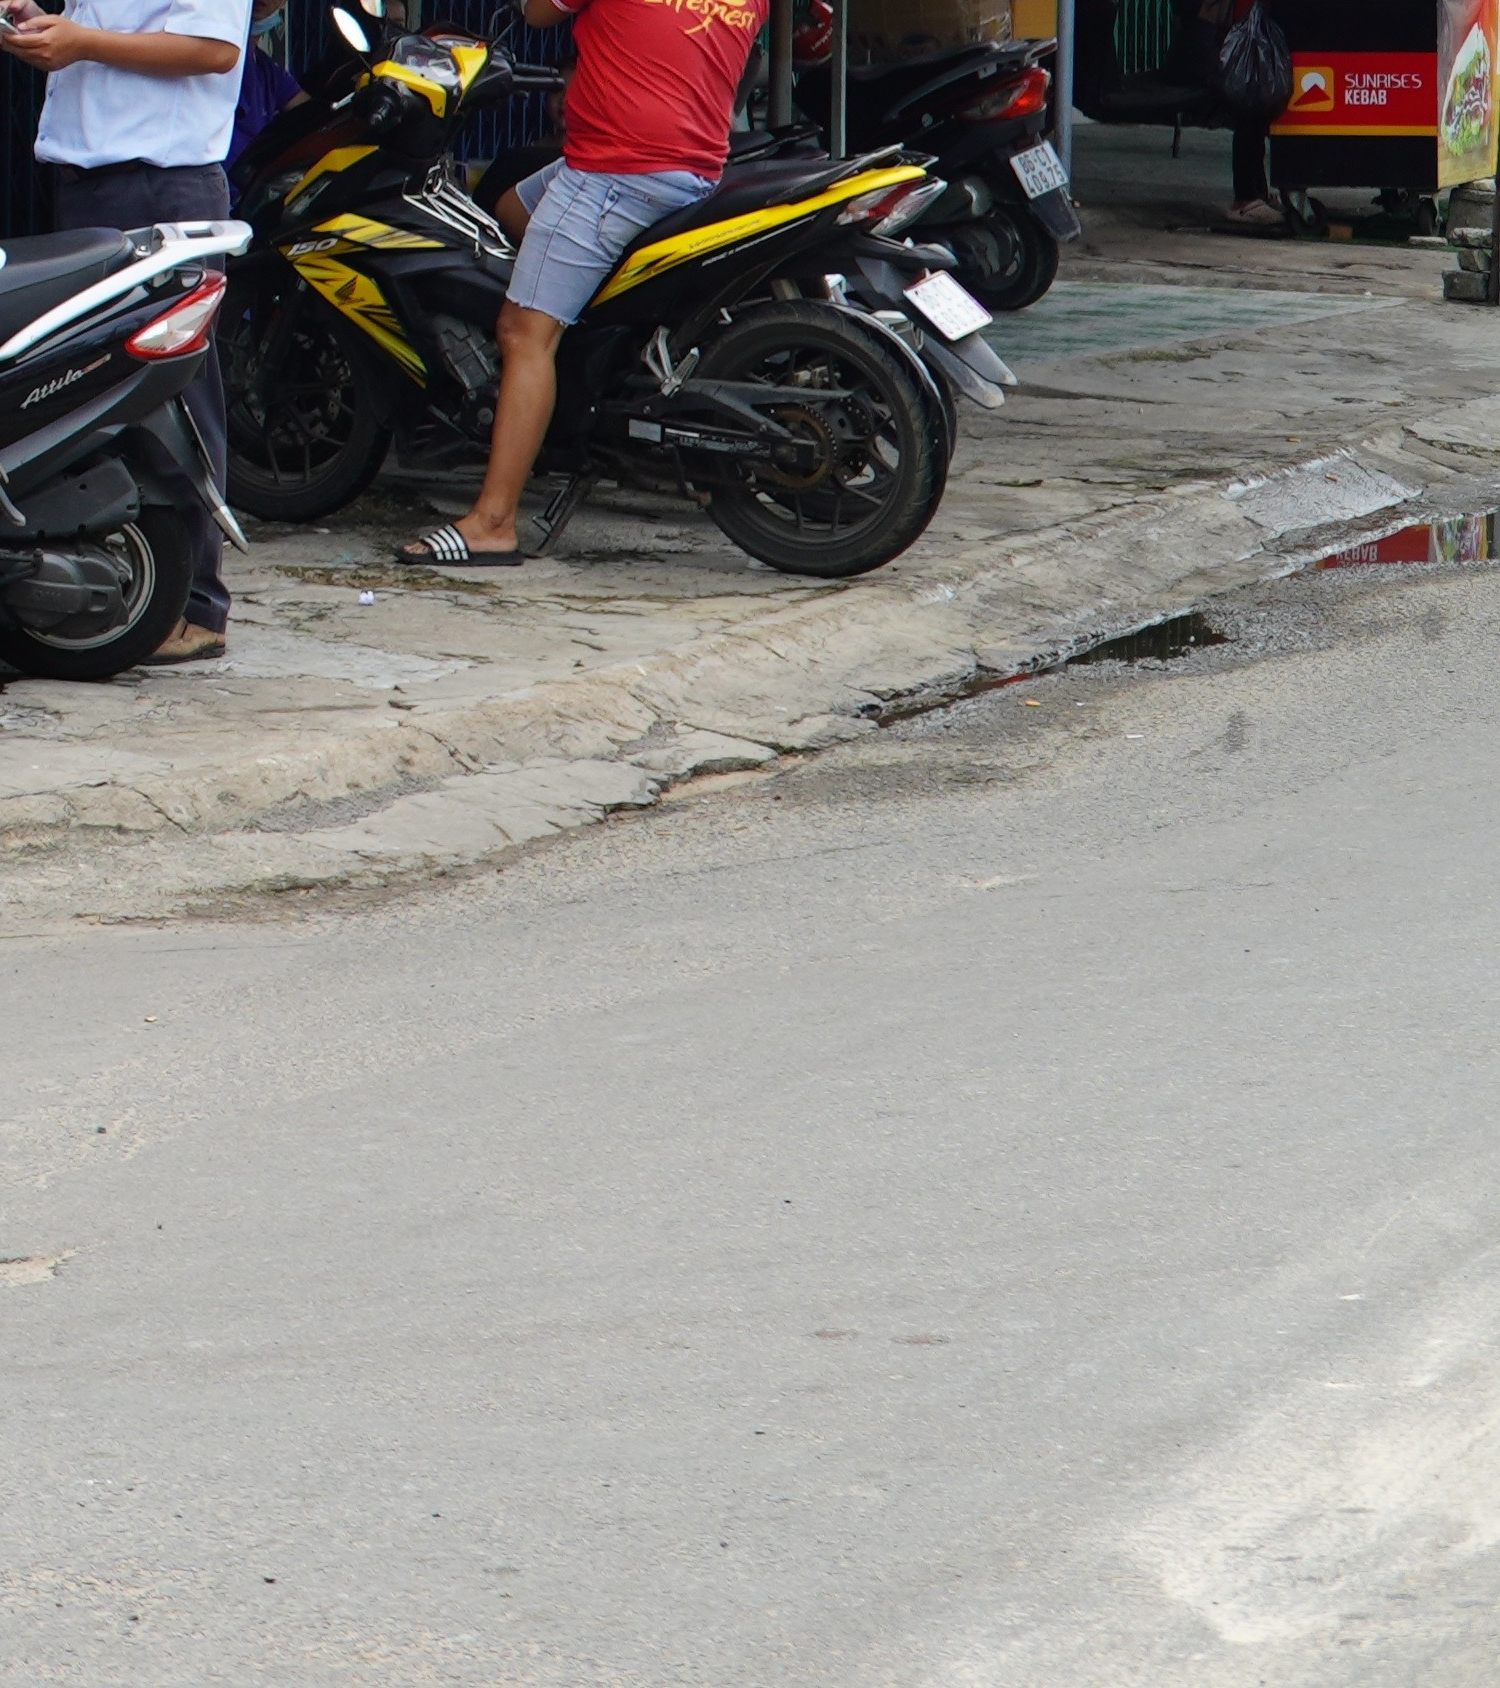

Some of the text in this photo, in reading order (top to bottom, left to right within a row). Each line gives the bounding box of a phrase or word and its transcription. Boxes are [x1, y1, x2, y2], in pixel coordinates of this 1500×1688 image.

[1344, 73, 1423, 89] SUNRISES
[1344, 89, 1388, 105] KEBAB
[286, 237, 340, 257] 150
[20, 368, 85, 410] Attila
